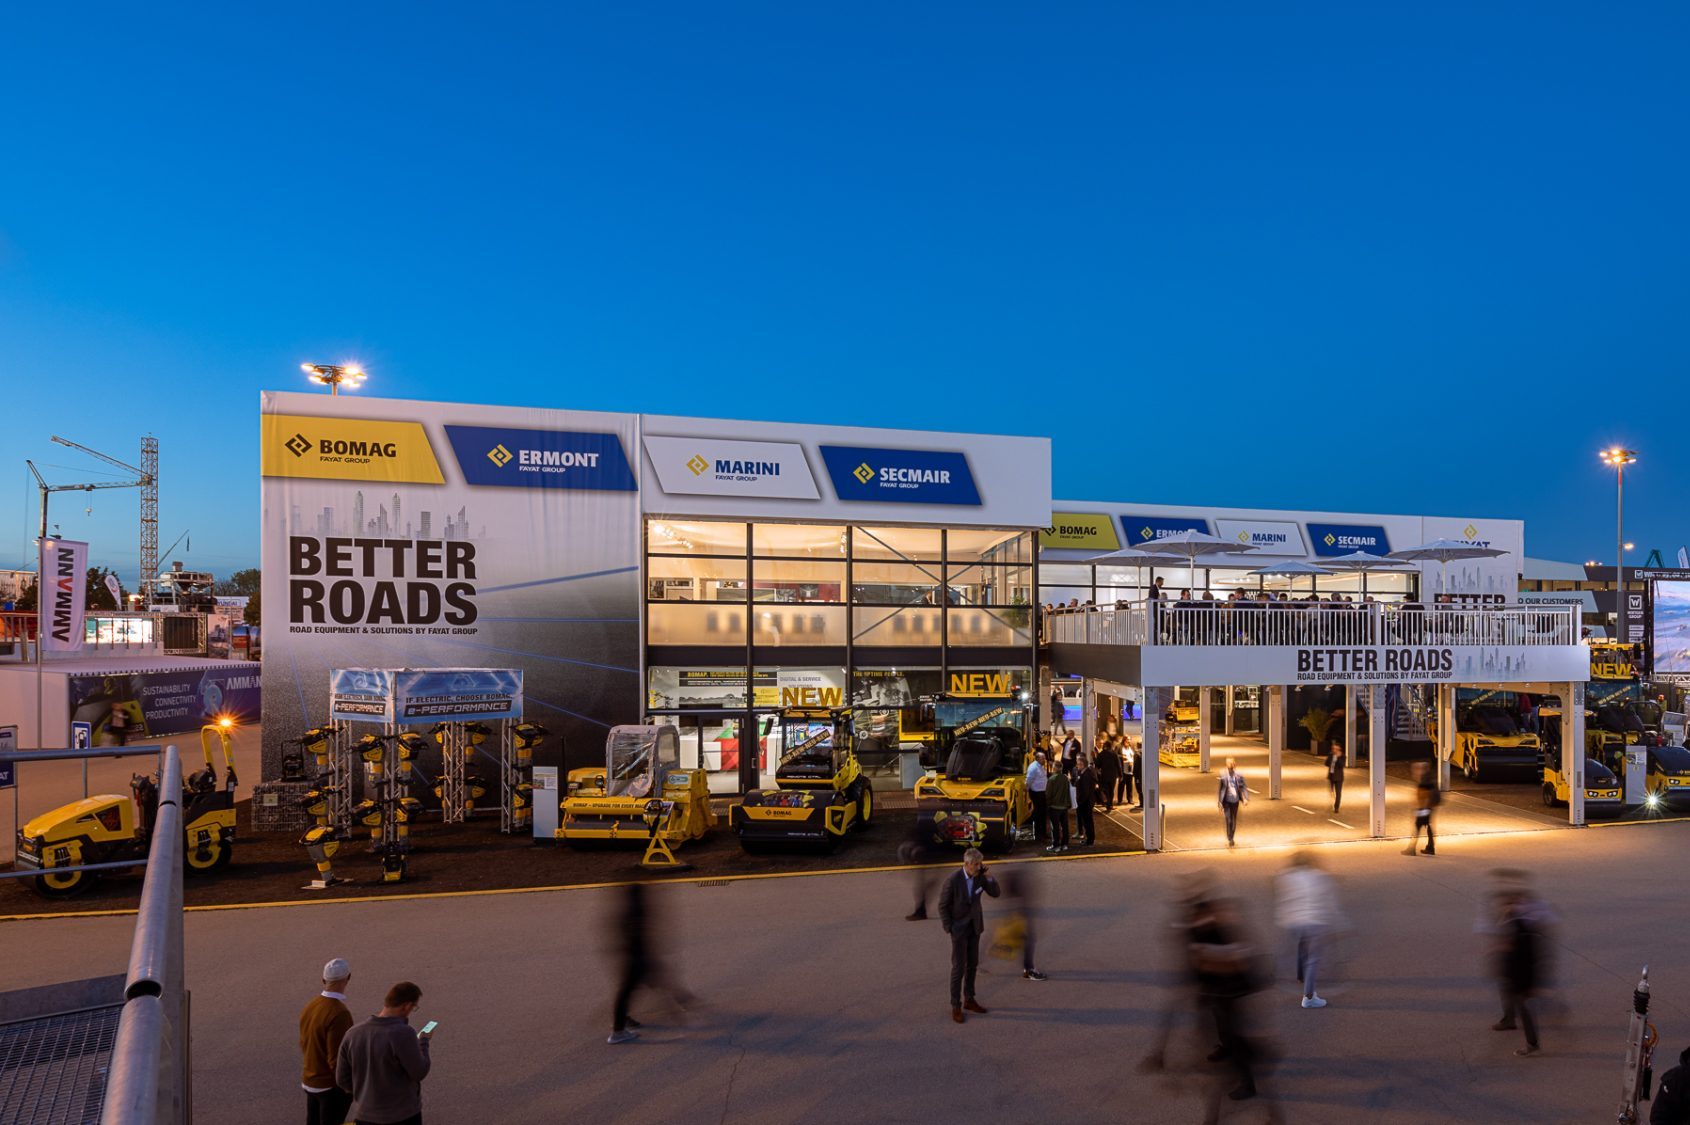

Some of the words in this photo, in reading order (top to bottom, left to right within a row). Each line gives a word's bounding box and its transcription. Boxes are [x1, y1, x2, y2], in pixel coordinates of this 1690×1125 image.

[320, 439, 396, 458] BOMAG
[519, 449, 599, 468] ERMONT
[715, 460, 780, 476] MARINI
[880, 467, 950, 484] SECMAIR
[1060, 526, 1097, 536] BOMAG
[1252, 532, 1286, 542] MARINI
[1338, 535, 1376, 546] SECMAIR
[290, 536, 477, 580] BETTER
[52, 548, 74, 642] AMMANN
[290, 580, 478, 626] ROADS
[1298, 648, 1378, 672] BETTER
[1386, 648, 1453, 672] ROADS
[1297, 672, 1316, 680] ROAD
[1318, 672, 1355, 680] EQUIPMENT
[1590, 663, 1632, 677] NEW
[142, 684, 192, 696] SUSTAINABILITY
[951, 674, 1009, 693] NEW
[154, 695, 196, 707] CONNECTIVITY
[782, 687, 842, 706] NEW
[145, 707, 188, 720] PRODUCTIVITY
[408, 702, 508, 714] e-PERFORMANCE
